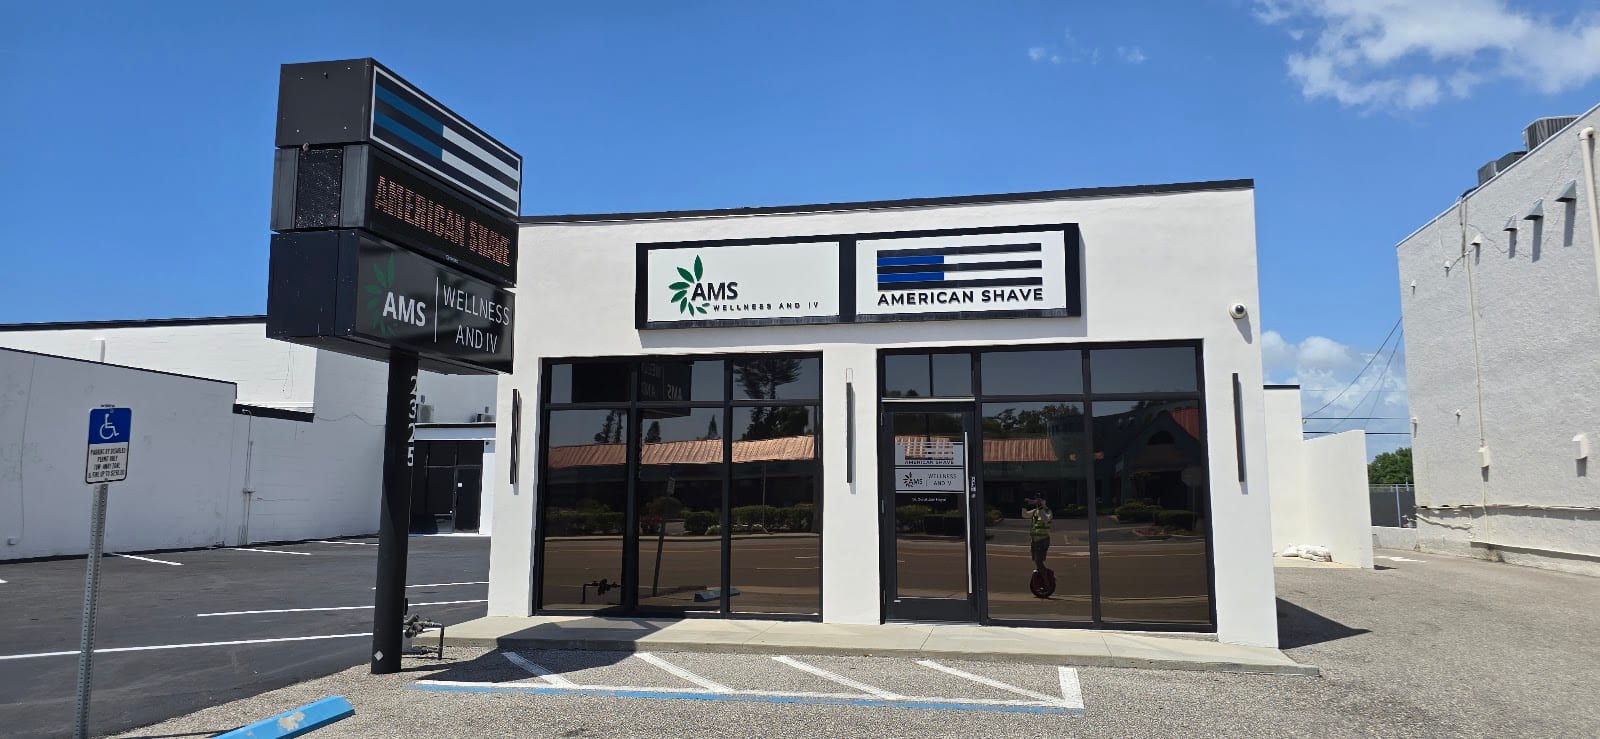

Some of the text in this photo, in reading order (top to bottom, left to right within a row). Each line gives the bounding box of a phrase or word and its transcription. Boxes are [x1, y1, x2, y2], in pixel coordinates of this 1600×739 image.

[374, 175, 511, 268] AMERICAN SHAVE
[443, 284, 511, 326] WELLNESS
[691, 281, 738, 301] AMS
[713, 303, 772, 312] WELLNESS
[808, 301, 819, 309] IV
[877, 287, 1043, 306] AMERICAN SHAVE
[382, 291, 427, 327] AMS
[455, 324, 498, 354] AND IV
[407, 375, 418, 467] 2325
